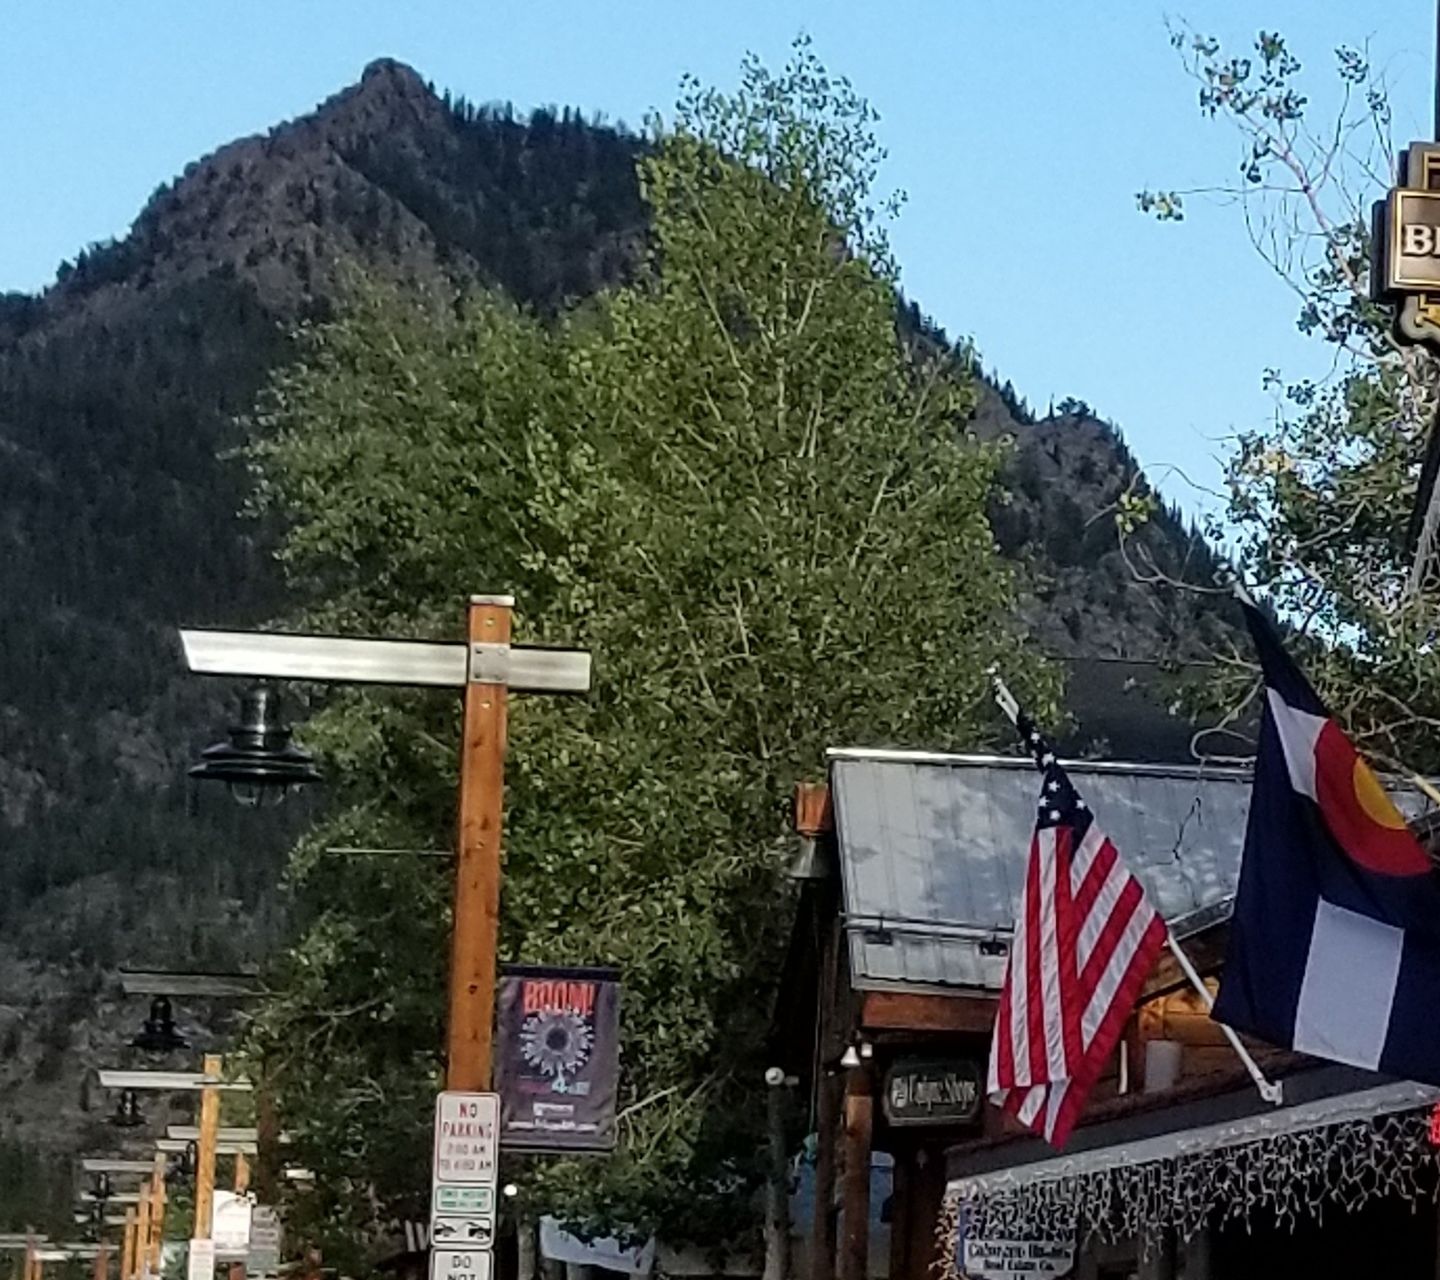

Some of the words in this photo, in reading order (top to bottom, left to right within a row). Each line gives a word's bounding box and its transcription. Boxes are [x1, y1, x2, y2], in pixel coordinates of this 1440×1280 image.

[522, 980, 596, 1016] BOOM!
[459, 1102, 478, 1119] NO
[442, 1121, 493, 1139] PARKING
[452, 1255, 472, 1269] DO
